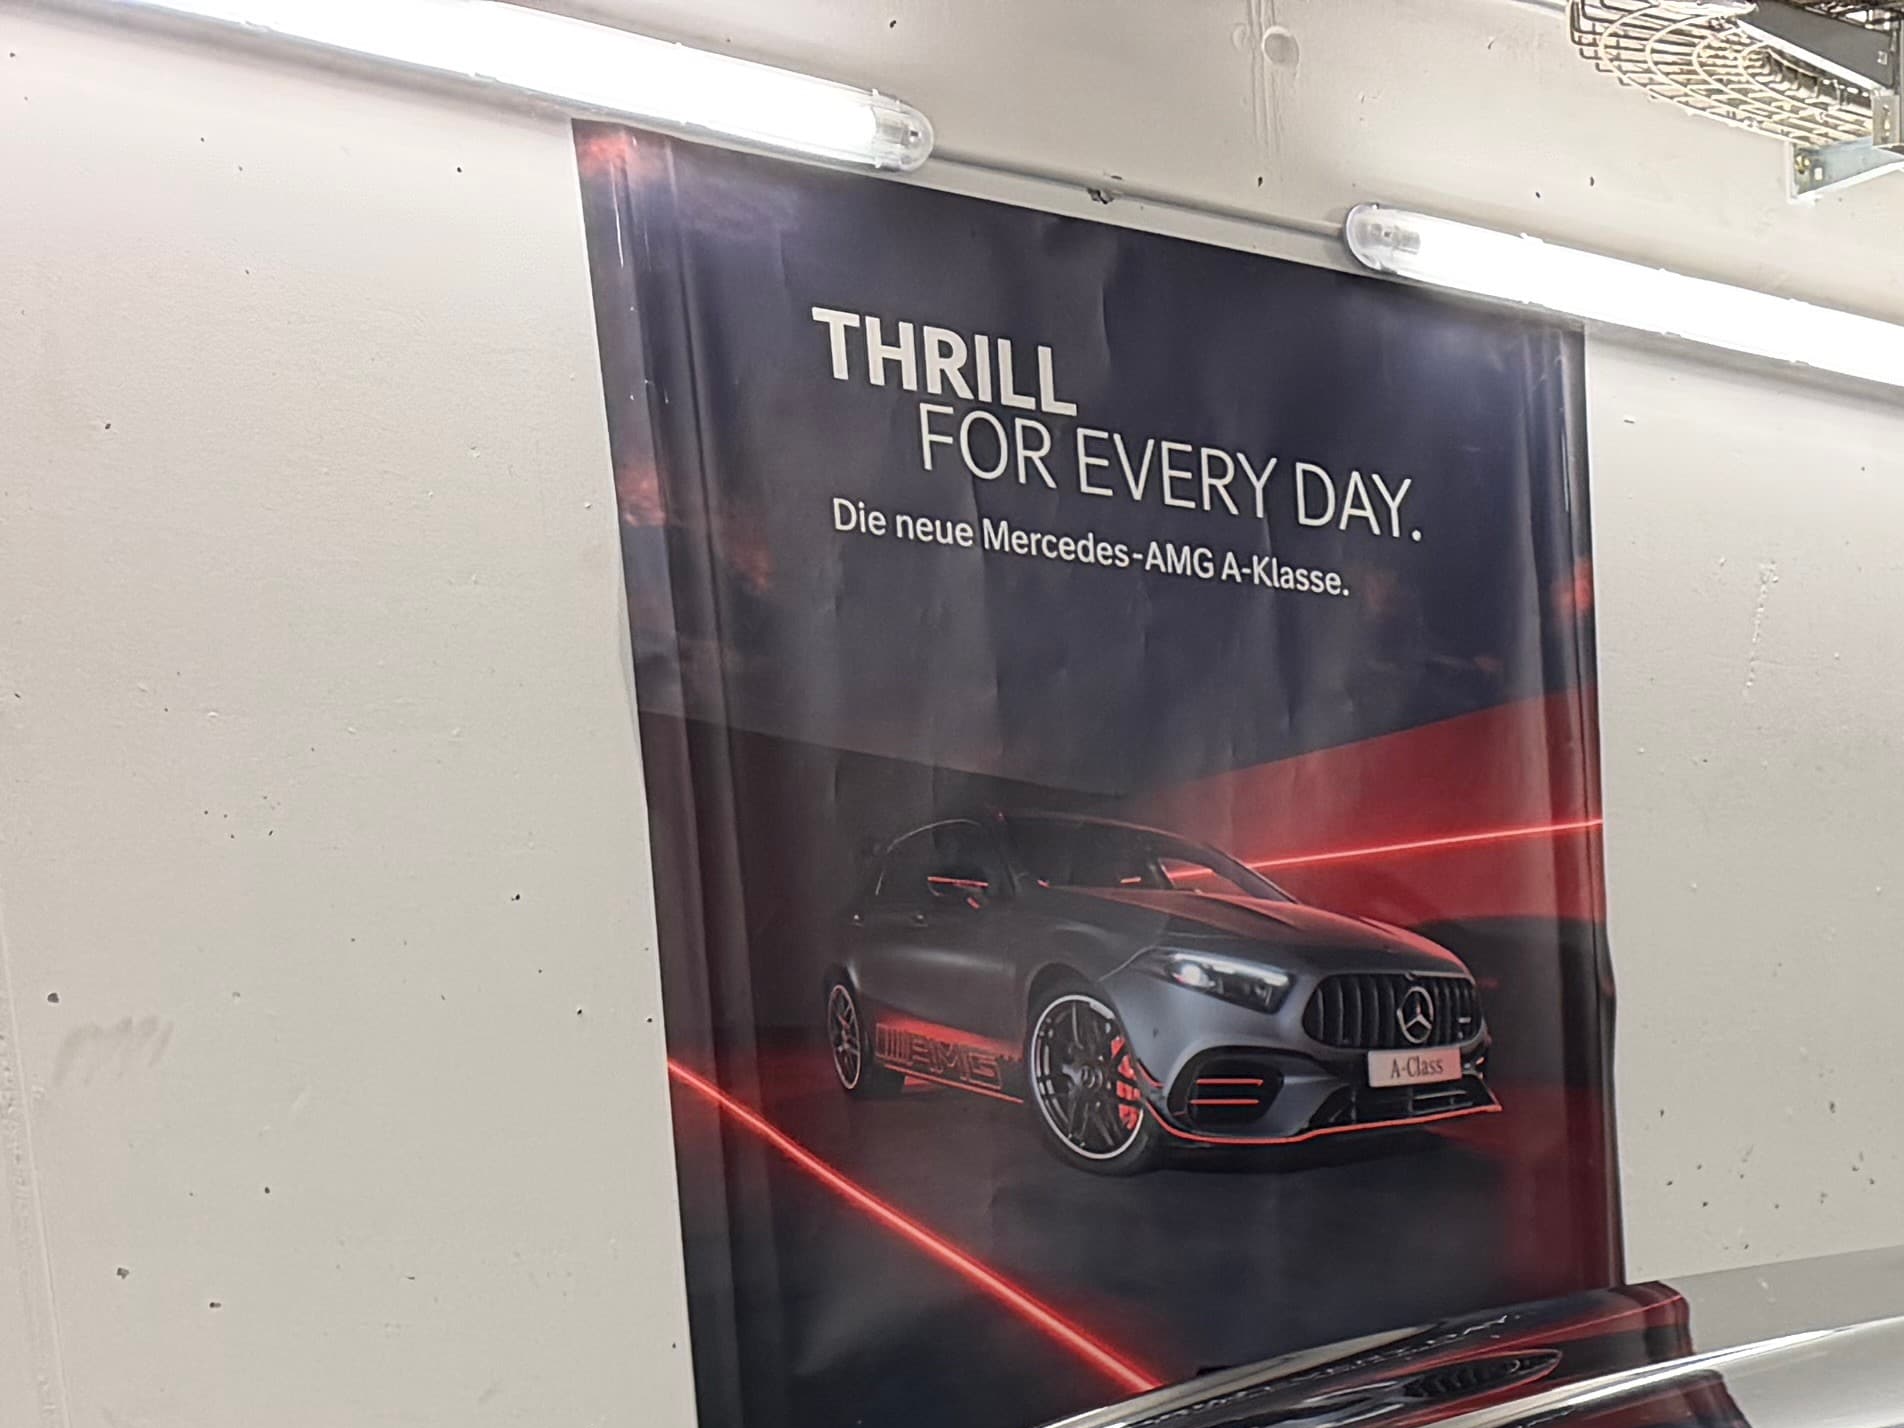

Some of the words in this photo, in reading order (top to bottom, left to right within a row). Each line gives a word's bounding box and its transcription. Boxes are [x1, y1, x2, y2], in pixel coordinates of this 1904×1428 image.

[812, 306, 1077, 416] THRILL
[920, 402, 1056, 489] FOR
[1076, 427, 1277, 518] EVERY
[1295, 462, 1422, 541] DAY.
[833, 497, 886, 535] Die
[896, 512, 974, 547] neue
[982, 518, 1215, 578] Mercedes-AMG
[1221, 552, 1350, 596] A-Klasse.
[1391, 1055, 1444, 1080] A-Class
